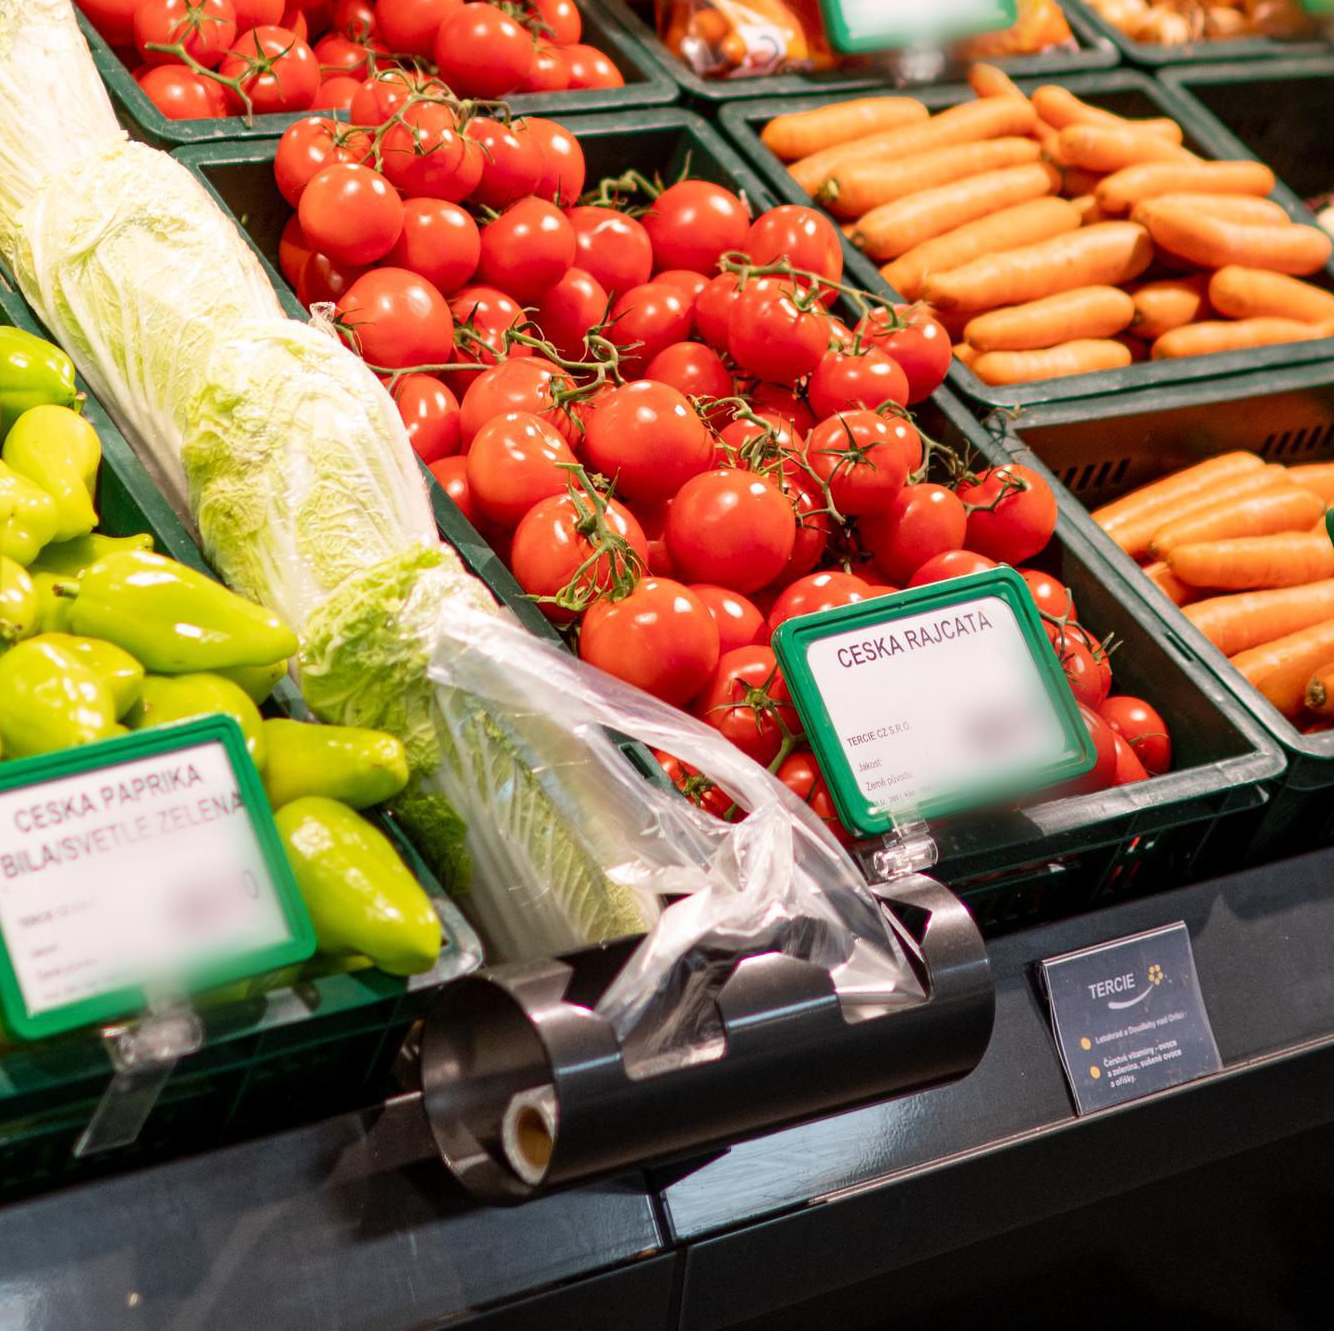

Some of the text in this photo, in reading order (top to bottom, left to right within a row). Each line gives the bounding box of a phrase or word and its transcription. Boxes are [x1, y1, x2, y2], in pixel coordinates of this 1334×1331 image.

[837, 610, 993, 669] CESKA RAJCATA
[847, 732, 876, 747] TERCIE
[876, 728, 889, 740] CZ
[13, 763, 203, 833] CESKA PAPRIKA
[158, 792, 246, 833] ZELENA
[1088, 973, 1136, 999] TERCIE
